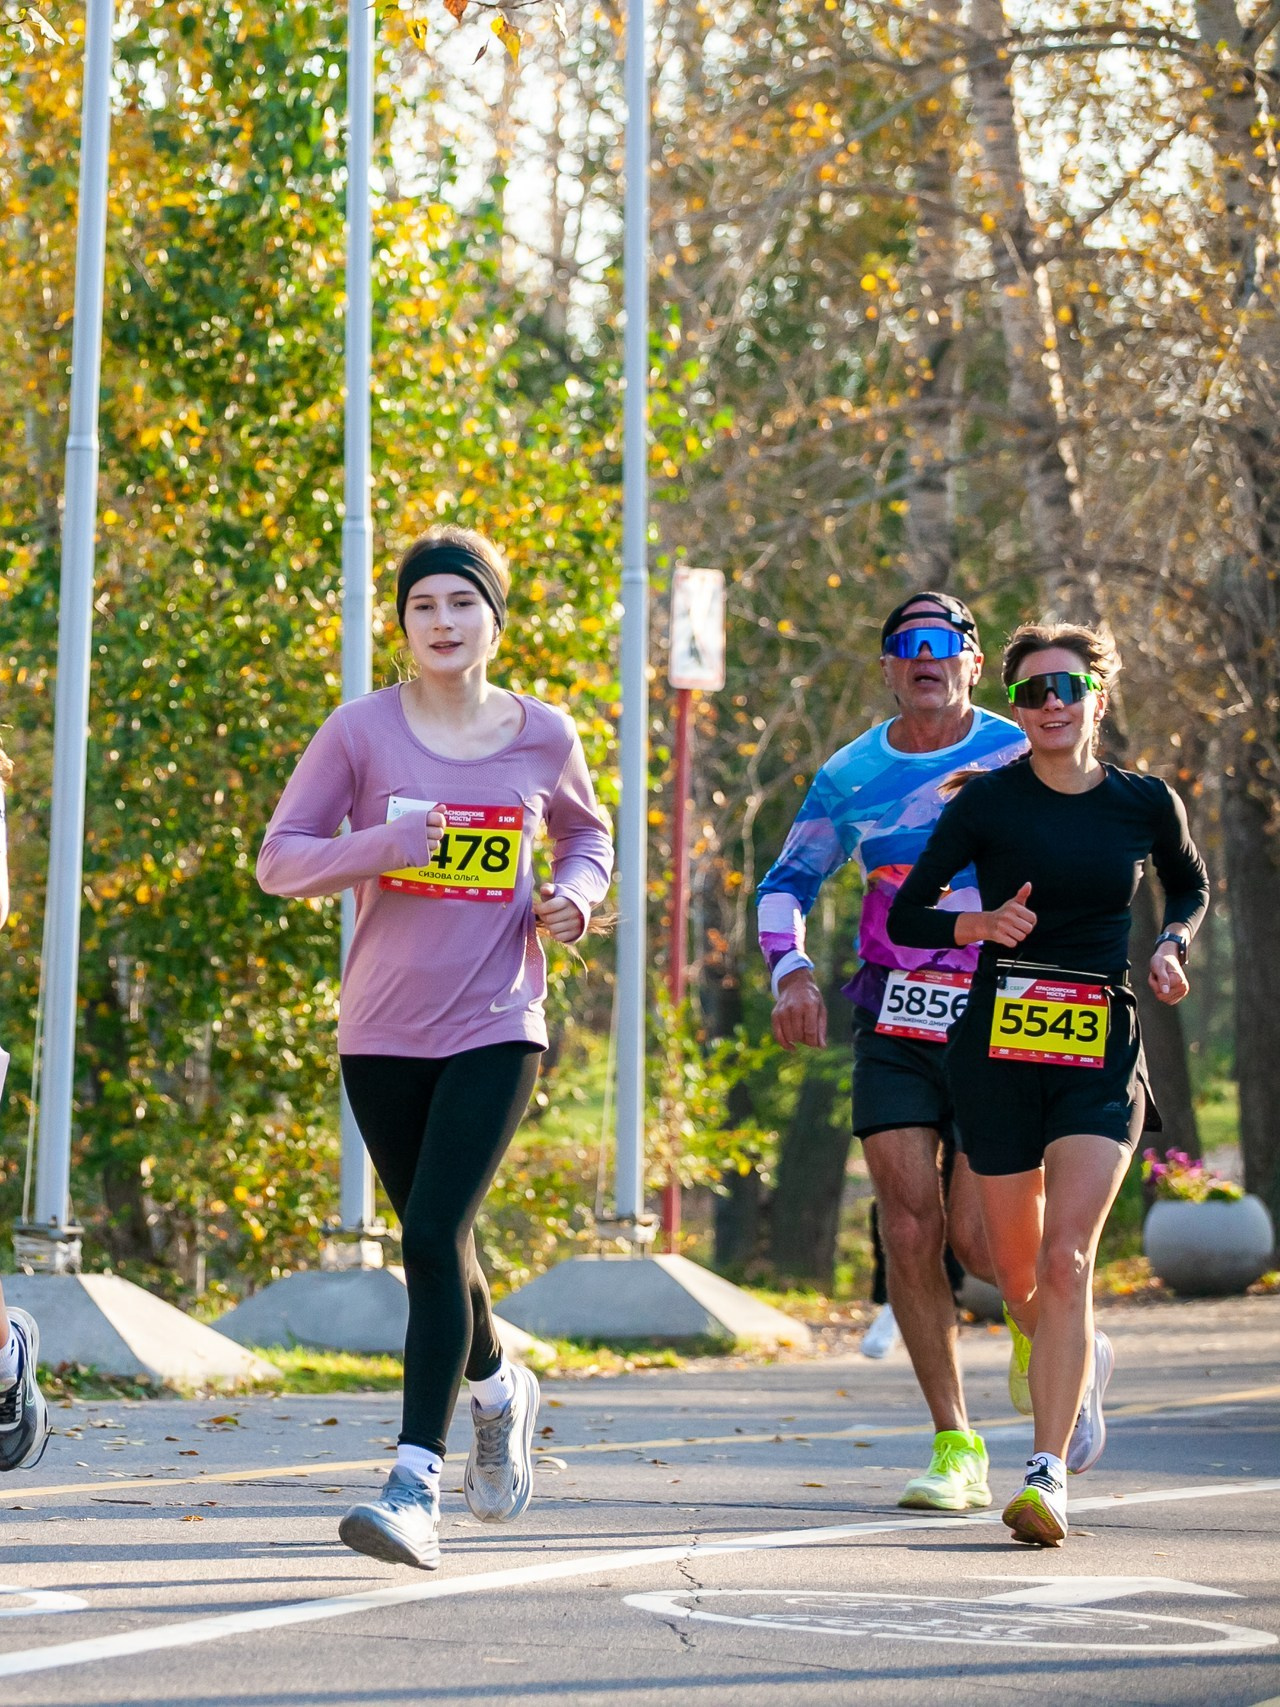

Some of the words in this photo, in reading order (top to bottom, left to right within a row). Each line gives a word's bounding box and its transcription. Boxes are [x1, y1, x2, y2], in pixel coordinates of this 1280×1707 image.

[444, 809, 485, 818] АСНОЯРСКИЕ
[431, 833, 511, 873] 478
[418, 870, 452, 880] СИЗОВА
[887, 984, 969, 1020] 5856
[999, 1003, 1099, 1042] 5543
